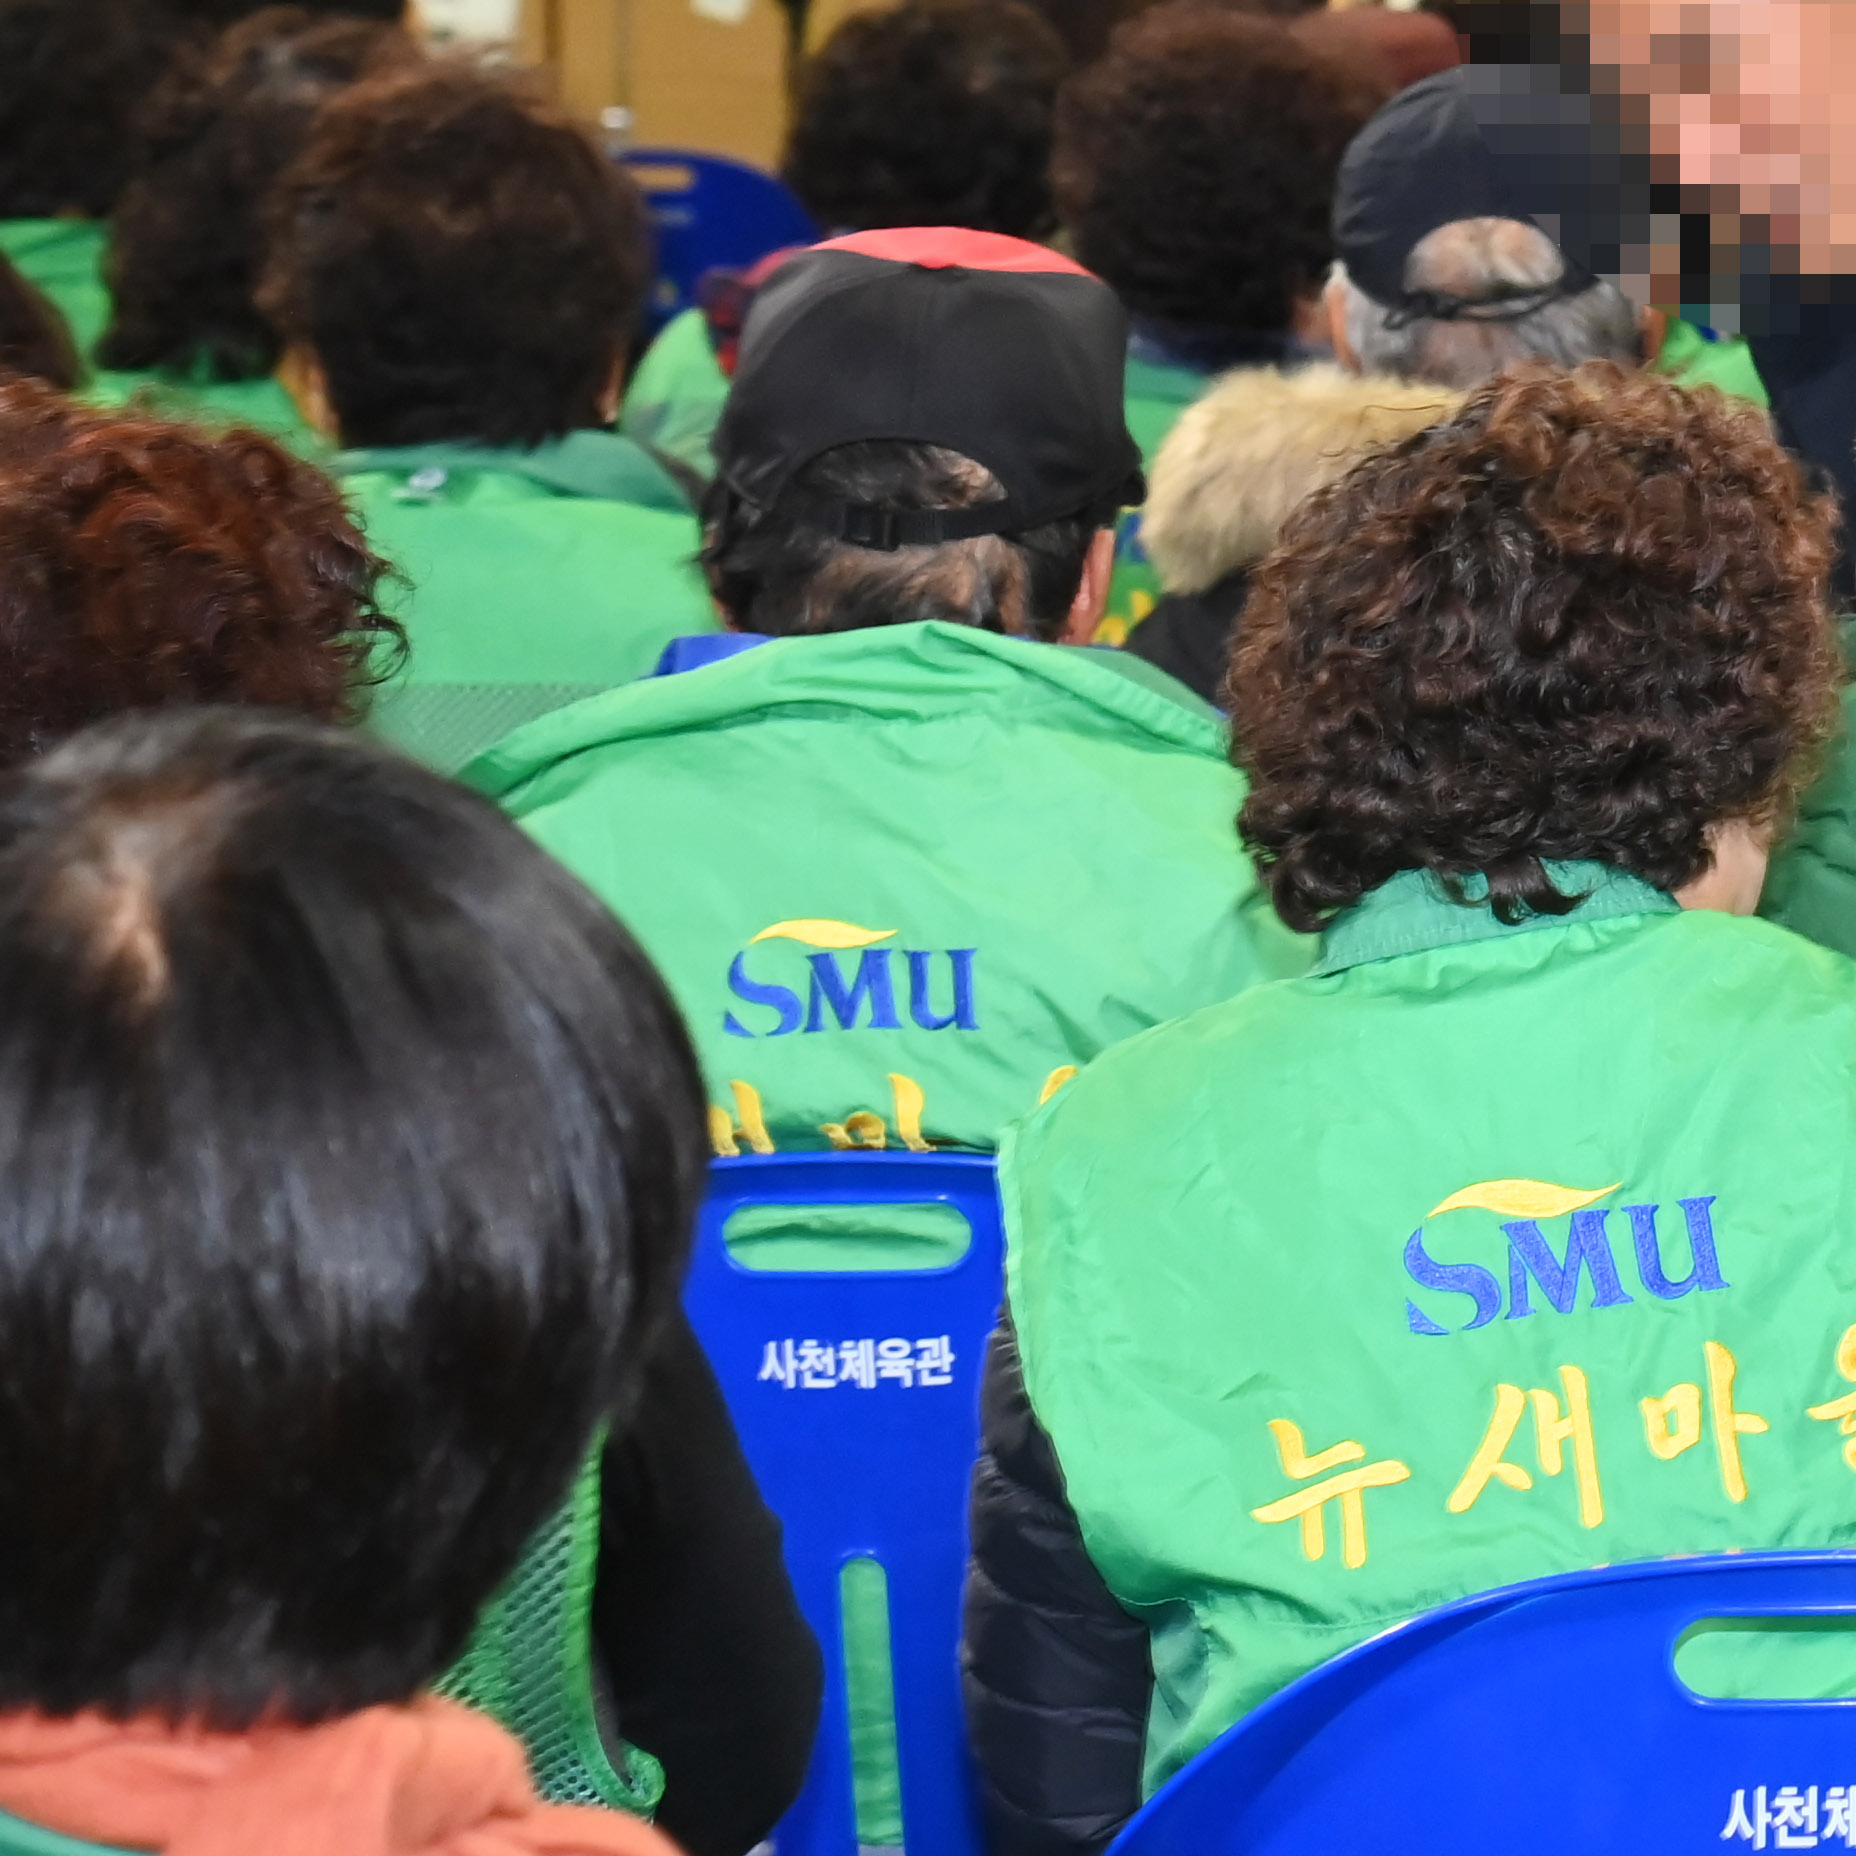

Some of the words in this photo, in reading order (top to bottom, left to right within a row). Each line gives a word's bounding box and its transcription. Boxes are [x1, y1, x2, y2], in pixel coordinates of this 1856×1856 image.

[722, 947, 982, 1038] SMU
[1403, 1194, 1731, 1336] SMU
[758, 1334, 956, 1390] 사천체육관
